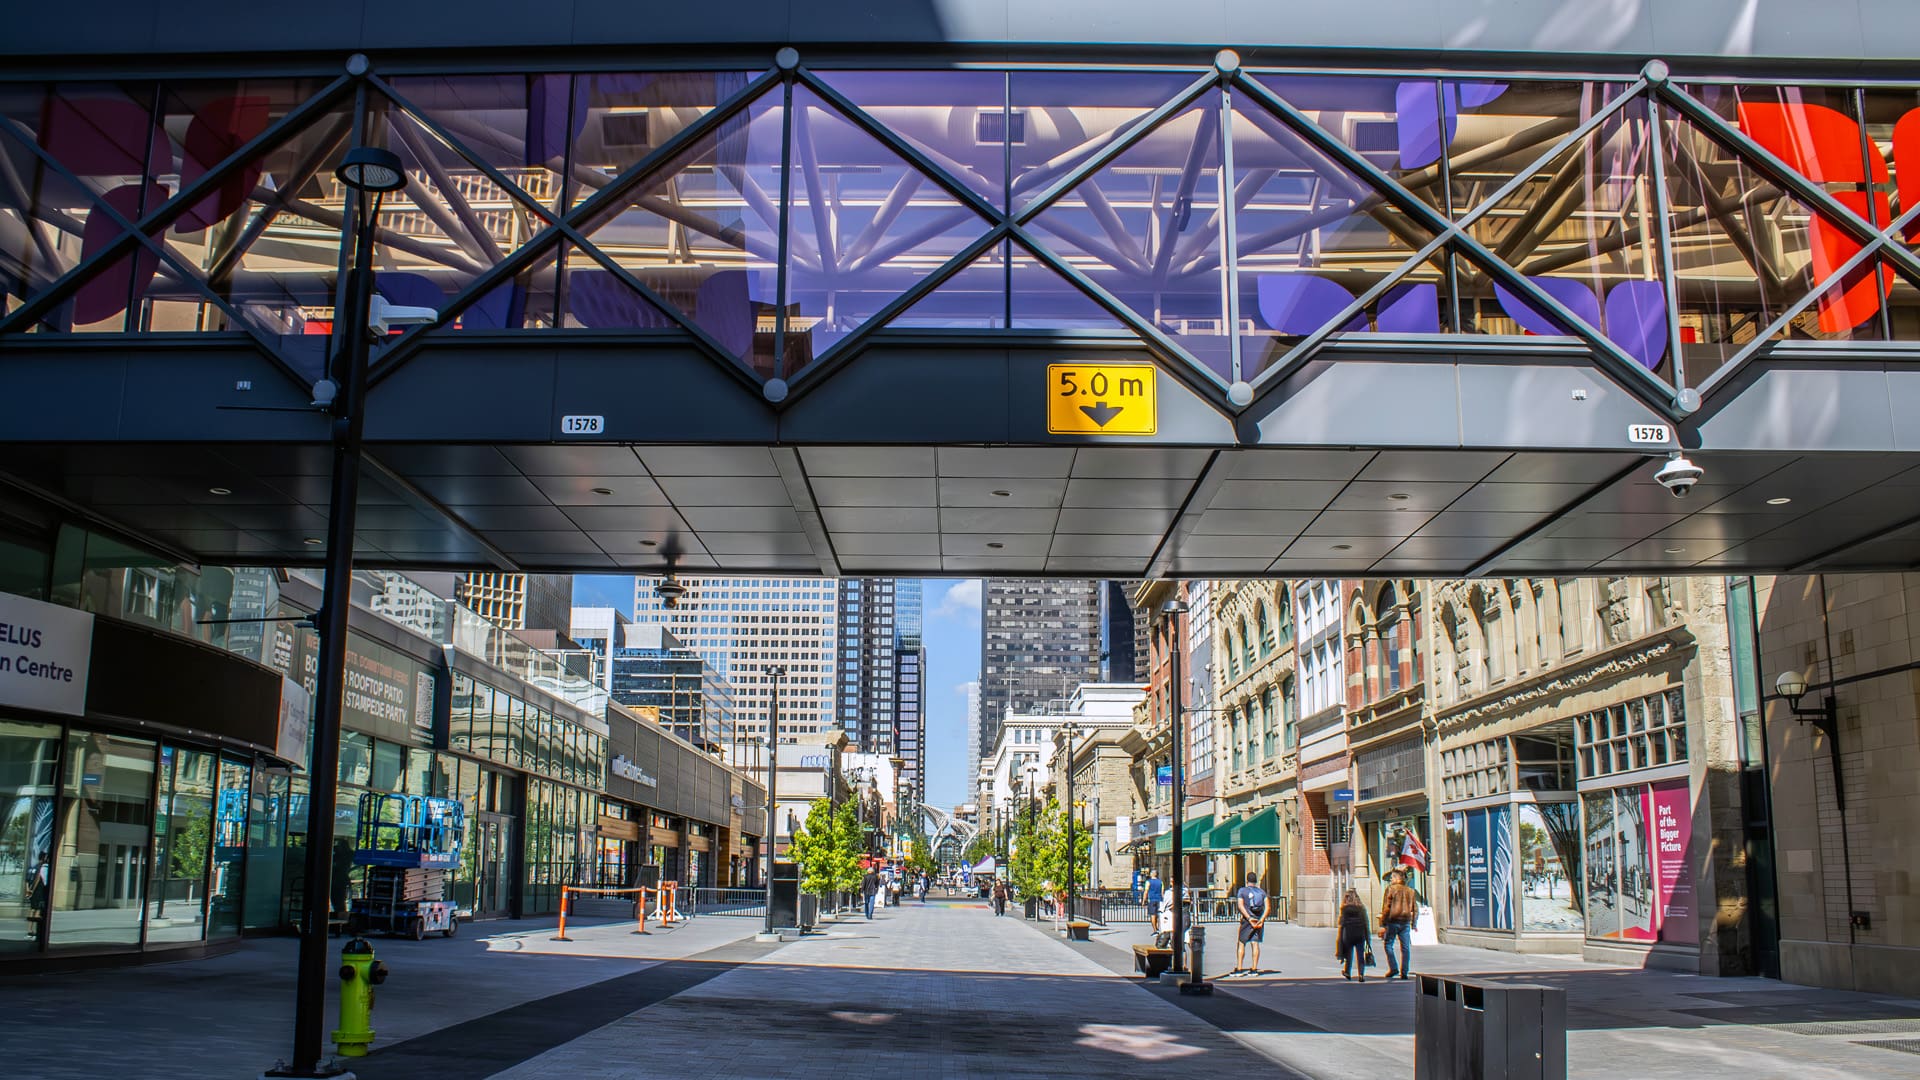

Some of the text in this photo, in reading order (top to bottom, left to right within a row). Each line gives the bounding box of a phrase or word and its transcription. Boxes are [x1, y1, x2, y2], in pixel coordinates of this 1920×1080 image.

[1060, 371, 1143, 397] 5.0 m
[567, 418, 598, 431] 1578
[1634, 427, 1664, 441] 1578
[15, 655, 73, 682] Centre
[305, 655, 318, 674] BO
[348, 671, 384, 697] ROOFTOP
[383, 683, 404, 704] PATIO
[346, 691, 385, 717] STAMPEDE
[1658, 805, 1671, 815] Part
[1660, 816, 1676, 827] of the
[1660, 829, 1679, 841] Bigger
[1661, 842, 1682, 852] Picture
